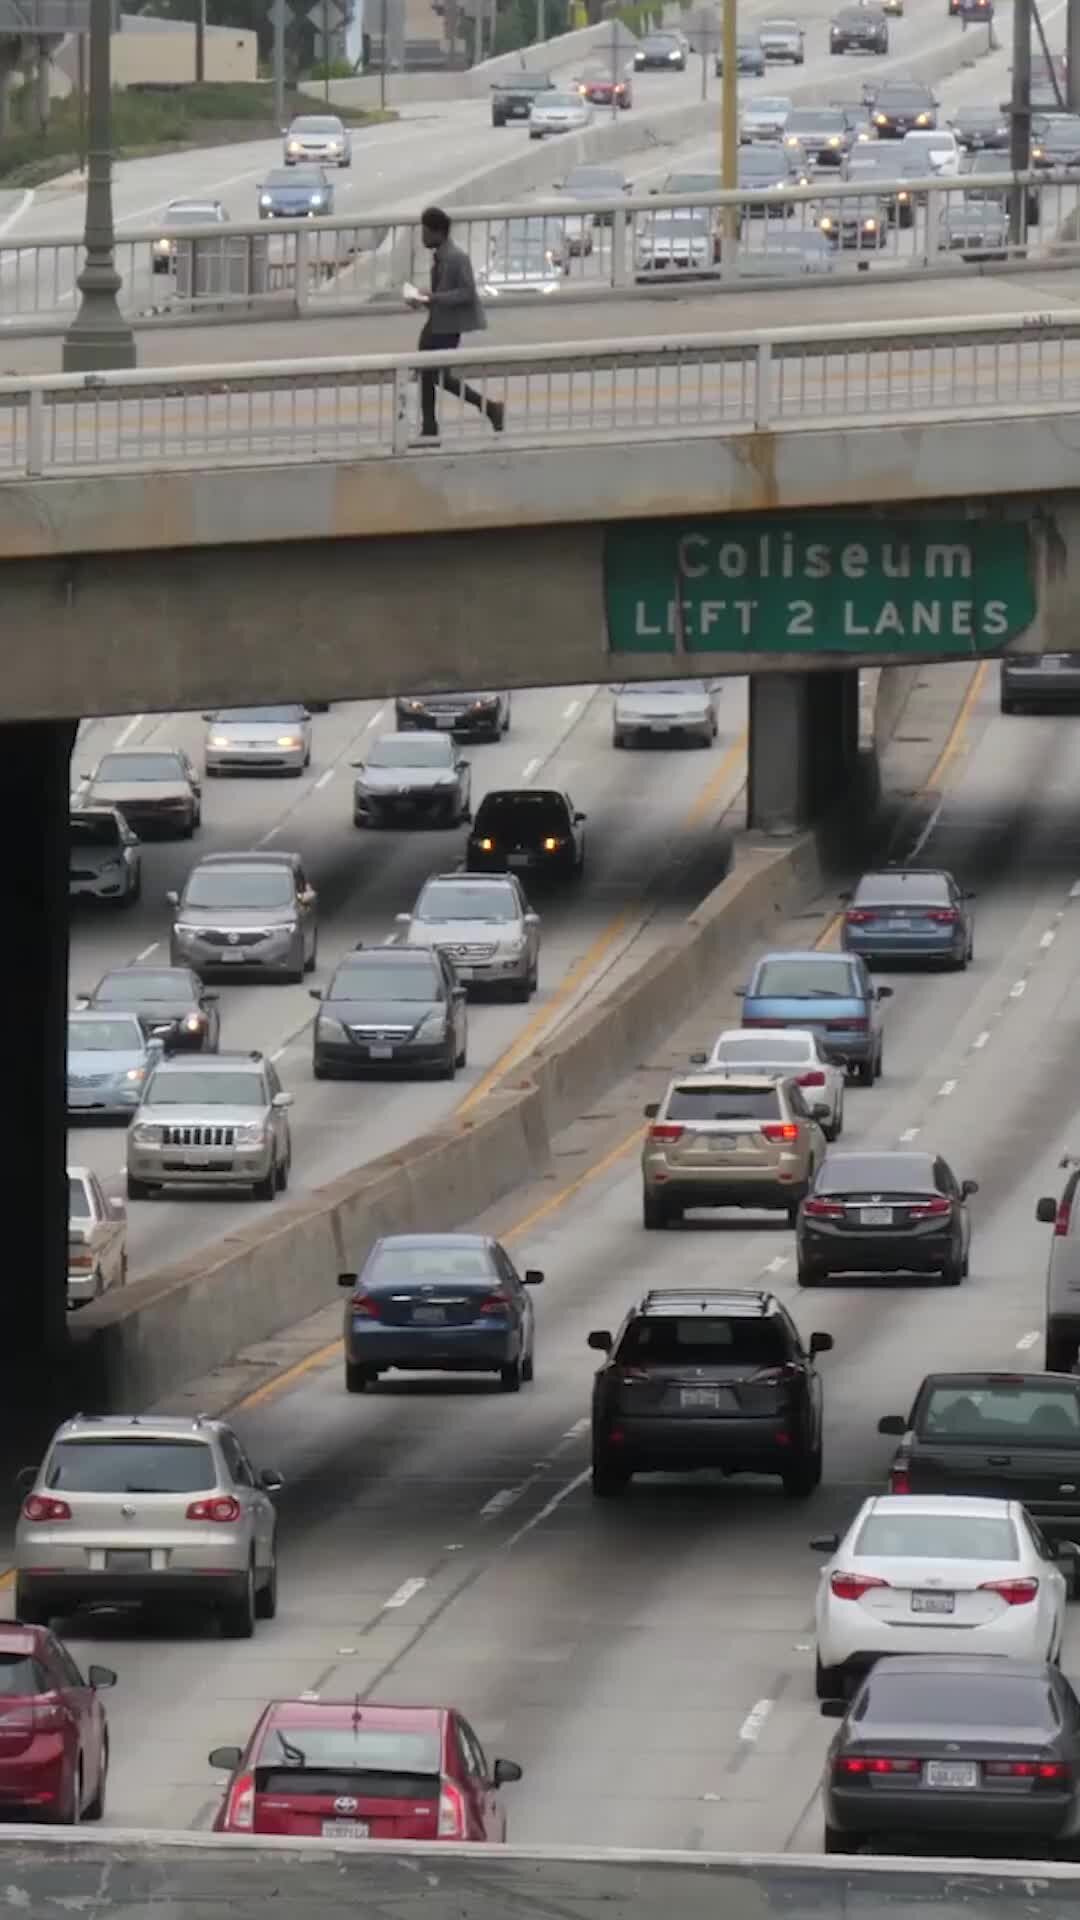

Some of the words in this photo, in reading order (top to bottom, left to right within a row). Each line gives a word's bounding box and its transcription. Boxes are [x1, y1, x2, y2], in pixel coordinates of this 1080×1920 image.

[679, 532, 971, 578] Coliseum
[635, 600, 758, 634] LEFT
[786, 601, 814, 634] 2
[844, 600, 1009, 634] LANES
